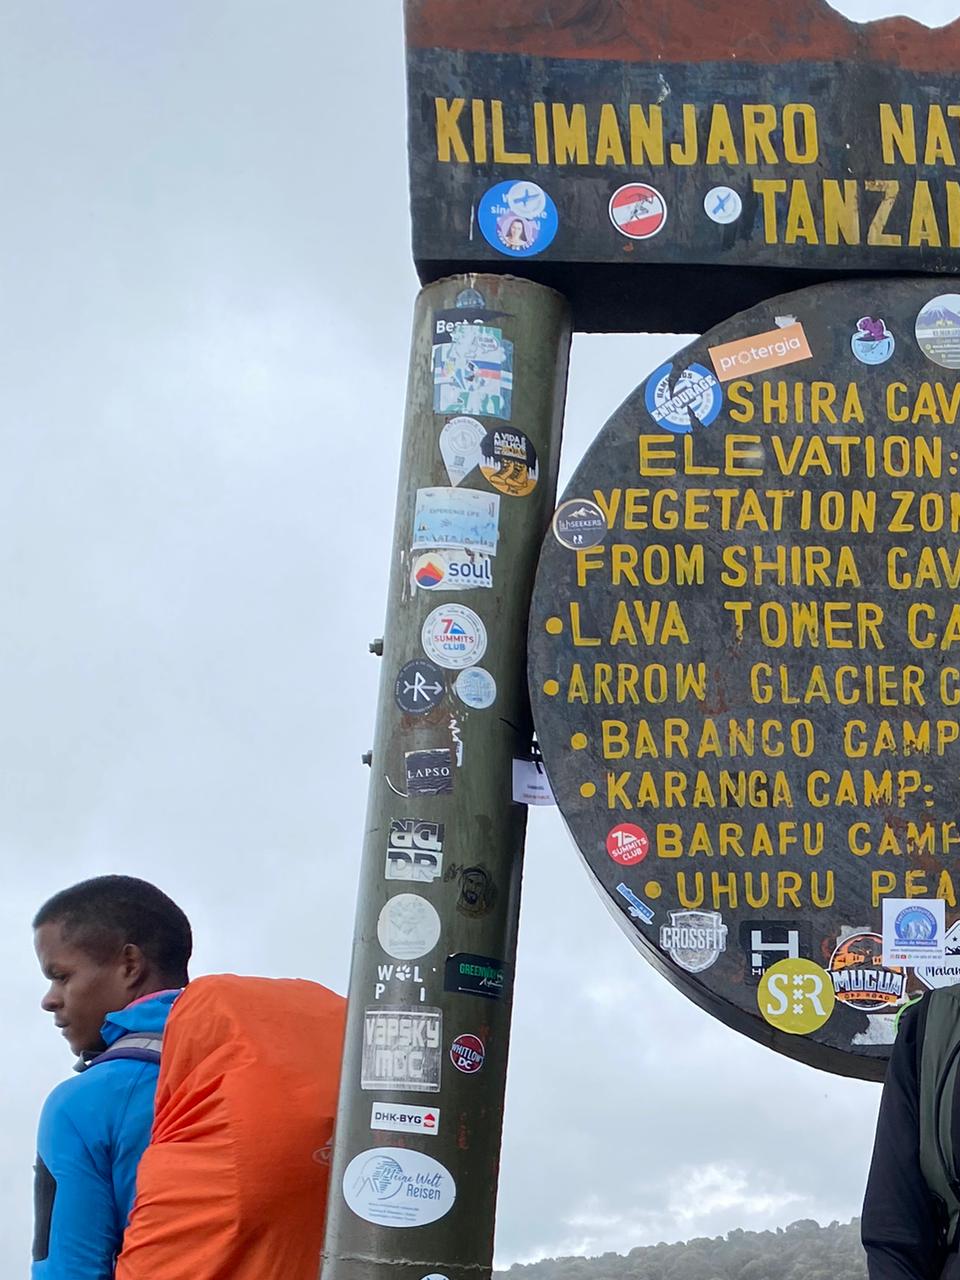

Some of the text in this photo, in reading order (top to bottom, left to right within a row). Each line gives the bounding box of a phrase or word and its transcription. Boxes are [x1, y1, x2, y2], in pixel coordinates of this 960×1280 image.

[436, 99, 820, 166] KILIMANJARO
[719, 335, 801, 373] protergia
[650, 374, 718, 422] ENTOURAGE
[727, 379, 865, 425] SHIRA
[638, 433, 958, 479] ELEVATION:
[593, 487, 877, 534] VEGETATION
[448, 558, 491, 581] soul
[576, 543, 705, 588] FROM
[720, 544, 861, 588] SHIRA
[434, 634, 475, 644] SUMMITS
[569, 599, 689, 647] LAVA
[723, 600, 885, 651] TOWER
[443, 643, 467, 652] CLUB
[567, 661, 707, 705] ARROW
[750, 661, 925, 707] GLACIER
[606, 770, 794, 810] KARANGA
[806, 769, 933, 808] CAMP:
[610, 837, 647, 858] SUMMITS
[621, 848, 643, 862] CLUB
[655, 820, 825, 859] BARAFU
[676, 870, 835, 910] UHURU
[661, 925, 728, 951] CROSSFIT
[832, 969, 906, 996] MUCUA
[869, 994, 891, 1002] ROAD
[457, 1059, 473, 1070] DC
[374, 1111, 422, 1125] DHK-BYG
[406, 1184, 441, 1200] Reisen
